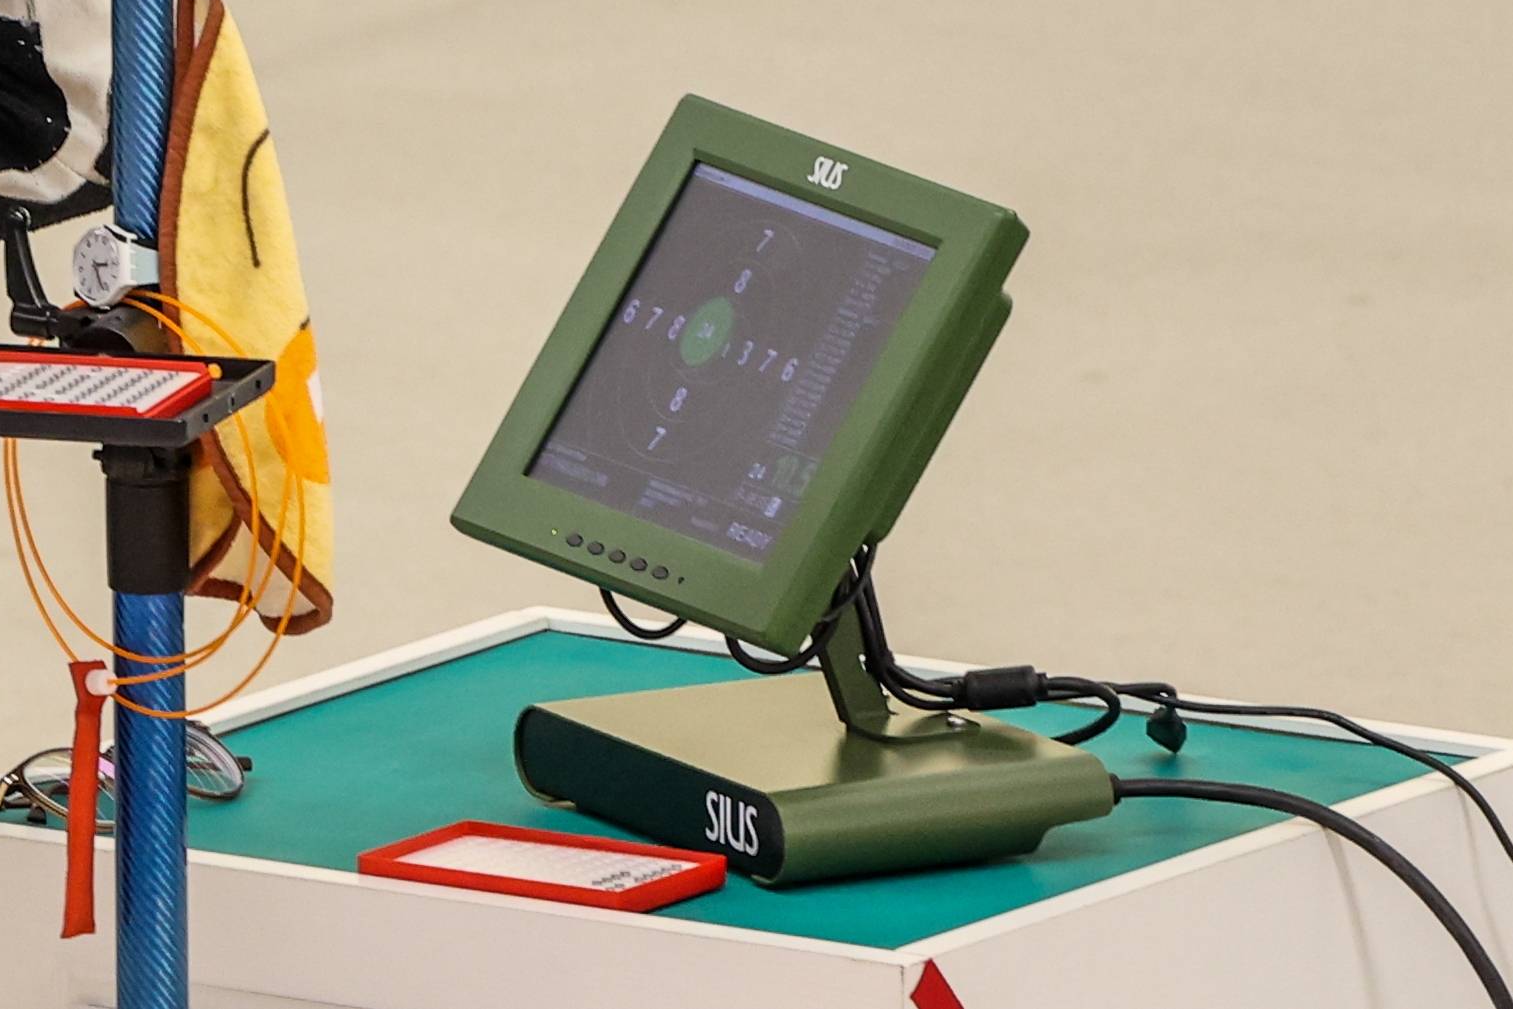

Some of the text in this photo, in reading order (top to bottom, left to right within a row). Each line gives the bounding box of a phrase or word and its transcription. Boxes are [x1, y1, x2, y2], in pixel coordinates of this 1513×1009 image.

[807, 156, 848, 190] SIUS
[756, 229, 775, 252] 7
[734, 269, 752, 293] 8
[623, 298, 640, 324] 6
[644, 306, 664, 330] 7
[758, 348, 778, 372] 7
[781, 358, 799, 382] 6
[669, 387, 687, 412] 8
[648, 426, 666, 450] 7
[705, 790, 759, 856] SIUS
